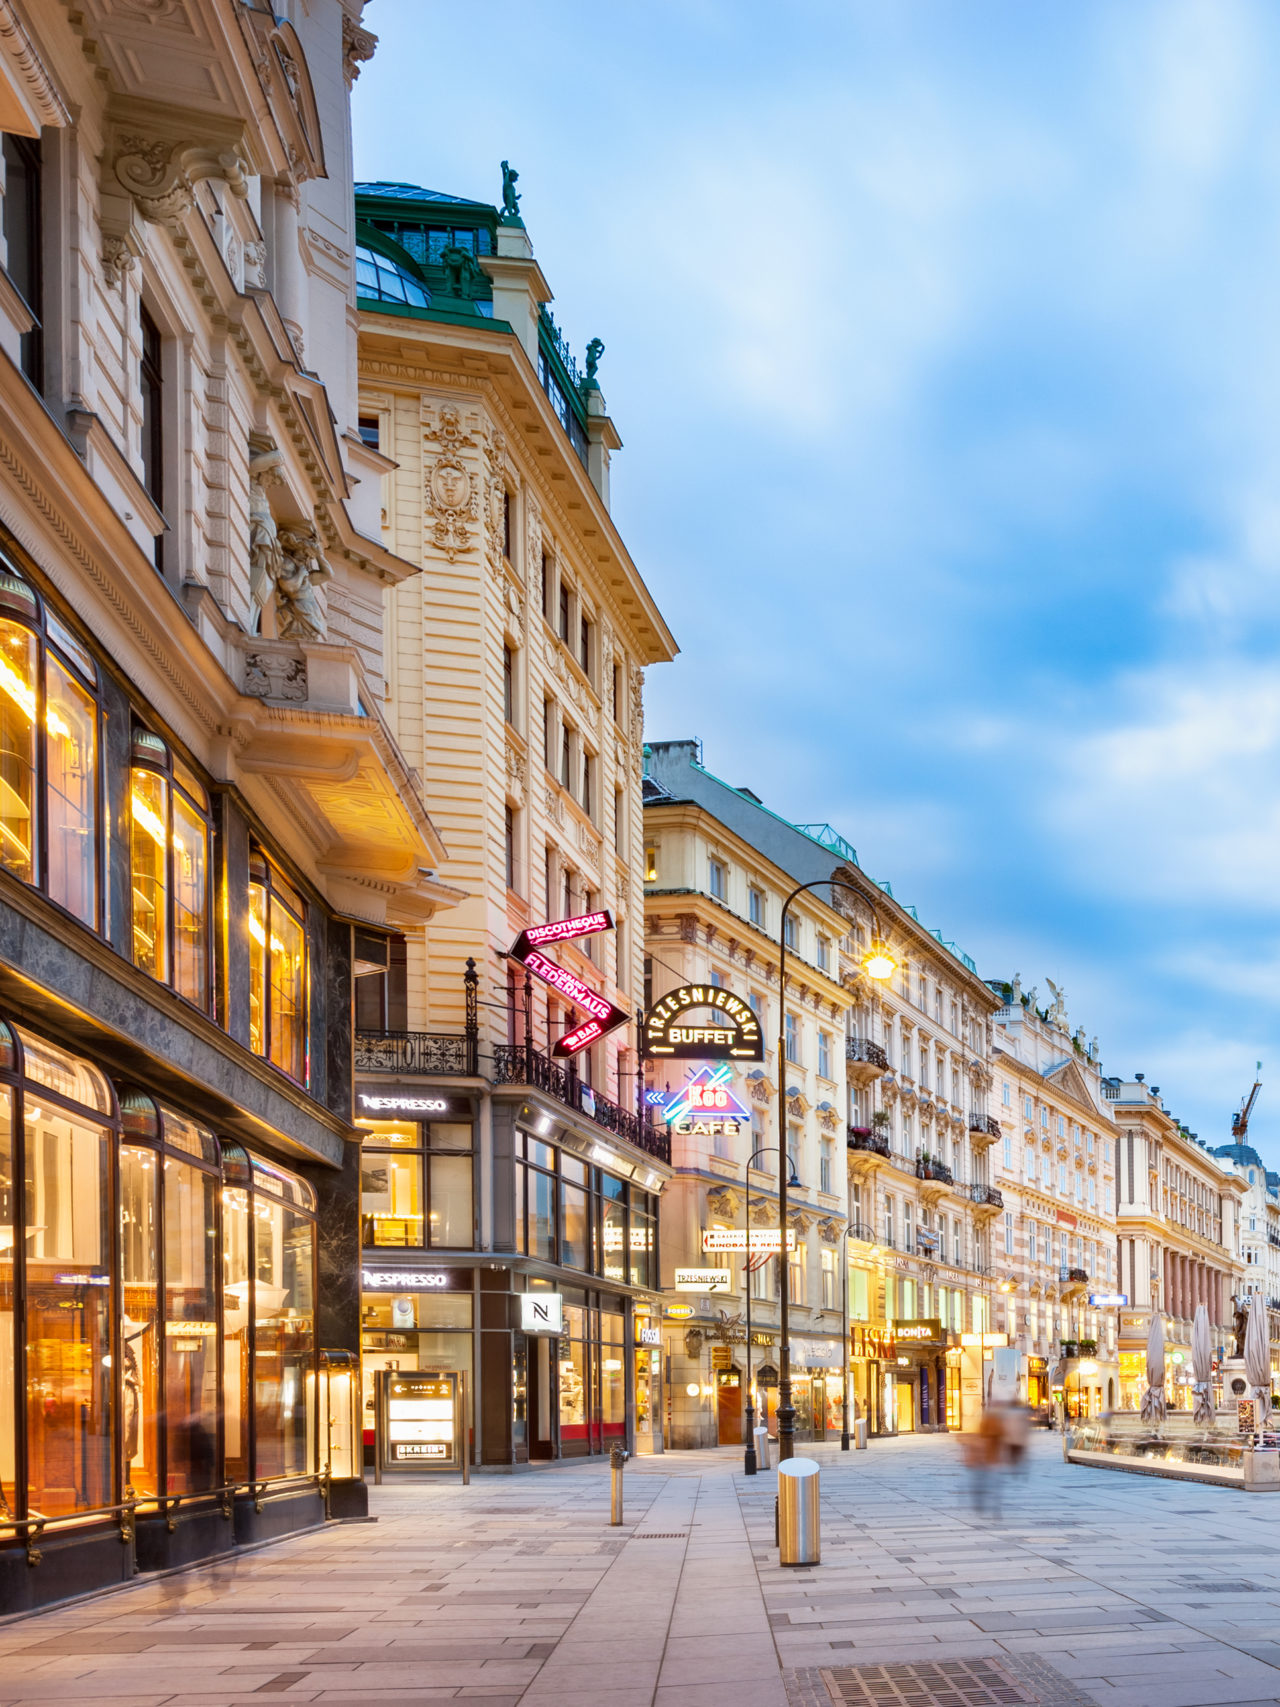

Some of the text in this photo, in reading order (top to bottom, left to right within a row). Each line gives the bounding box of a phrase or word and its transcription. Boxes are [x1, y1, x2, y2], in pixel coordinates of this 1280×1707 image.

[526, 913, 606, 940] DISCOTHEQUE
[523, 954, 612, 1020] FLEDERMAUS
[557, 968, 588, 991] CABARET
[578, 1021, 600, 1039] BAR
[668, 1029, 736, 1044] BUFFET
[358, 1094, 446, 1110] NESPRESSO
[361, 1270, 446, 1287] NESPRESSO
